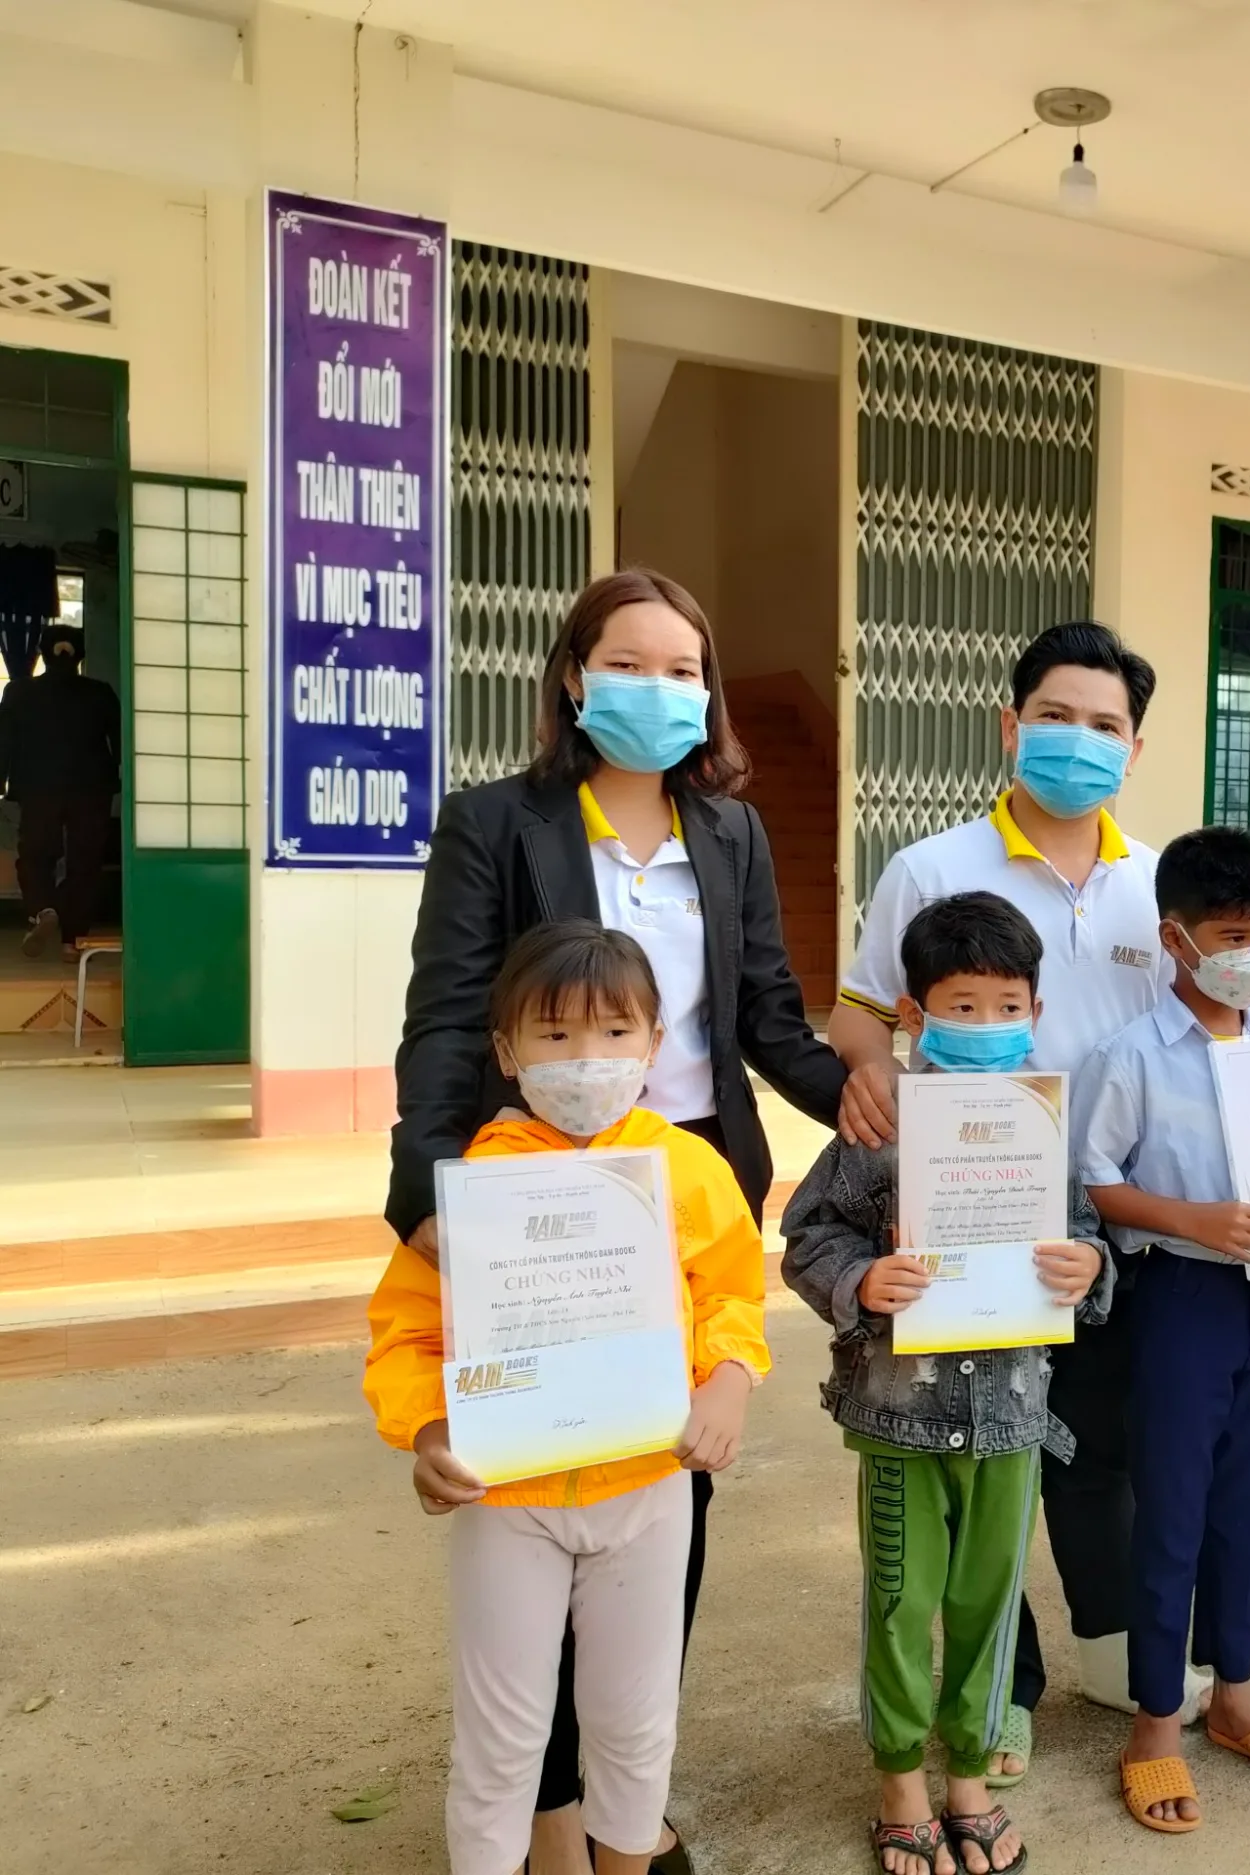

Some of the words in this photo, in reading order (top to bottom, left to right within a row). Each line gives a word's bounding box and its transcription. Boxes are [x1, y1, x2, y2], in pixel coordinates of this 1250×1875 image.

[308, 250, 367, 323] ĐOÀN
[373, 254, 412, 329] KẾT
[318, 340, 354, 421] ĐỔI
[361, 358, 401, 429] MỚI
[297, 451, 354, 523] THÂN
[359, 459, 420, 542] THIỆN
[295, 551, 317, 622] VÌ
[322, 566, 372, 638] MỤC
[376, 560, 422, 630] TIÊU
[294, 647, 349, 725] CHẤT
[354, 664, 424, 740] LƯỢNG
[309, 755, 360, 826] GIÁO
[364, 769, 408, 840] DỤC
[940, 1168, 991, 1183] CHỨNG
[996, 1166, 1033, 1182] NHẬN
[504, 1269, 571, 1290] CHỨNG
[576, 1263, 626, 1282] NHẬN
[614, 1246, 636, 1255] BOOKS
[506, 1354, 539, 1370] BOOKS
